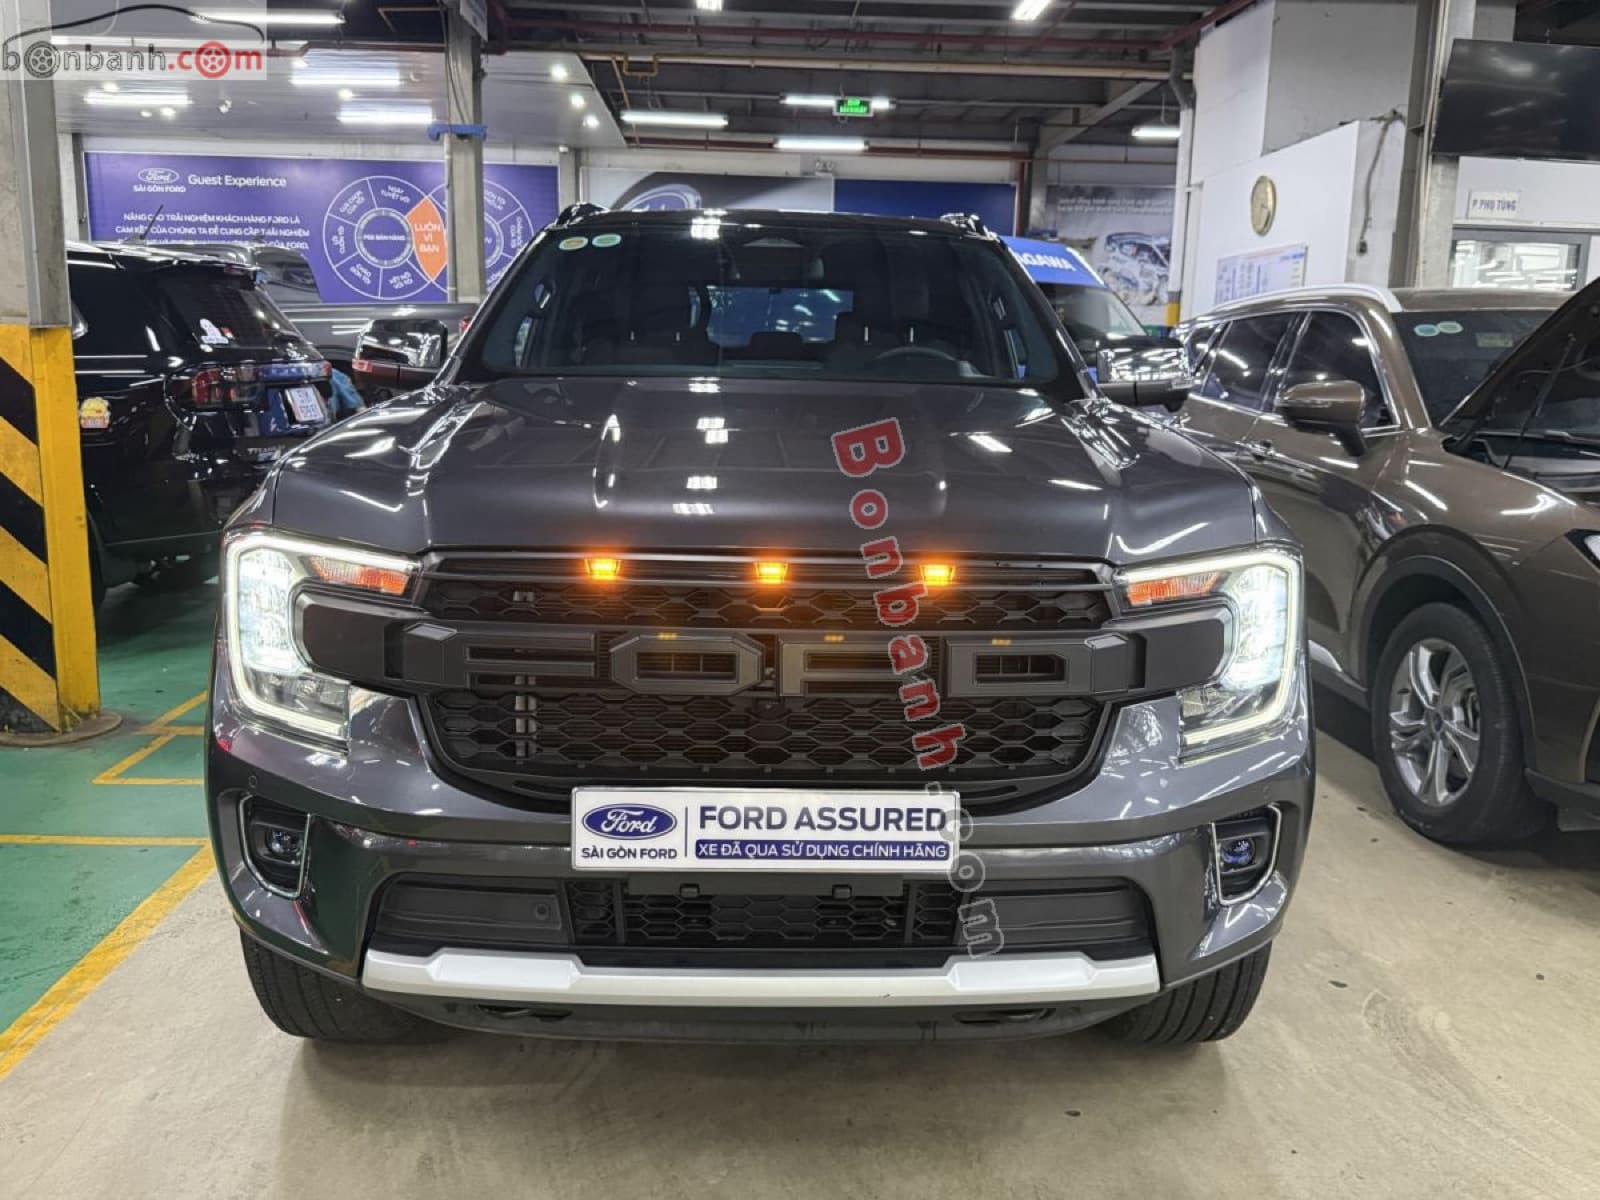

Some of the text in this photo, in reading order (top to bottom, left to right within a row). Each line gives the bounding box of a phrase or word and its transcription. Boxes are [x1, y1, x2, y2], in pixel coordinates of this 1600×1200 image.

[164, 185, 186, 193] FORD
[188, 174, 287, 188] Guest Experience
[601, 808, 659, 833] Ford
[700, 806, 946, 831] FORD ASSURED
[581, 844, 678, 859] SÀI GÒN FORD
[699, 843, 718, 856] XE
[720, 841, 742, 856] ĐÃ
[744, 843, 778, 859] QUA
[782, 840, 804, 856] SỬ
[806, 843, 850, 860] DỤNG
[852, 841, 900, 857] CHÍNH
